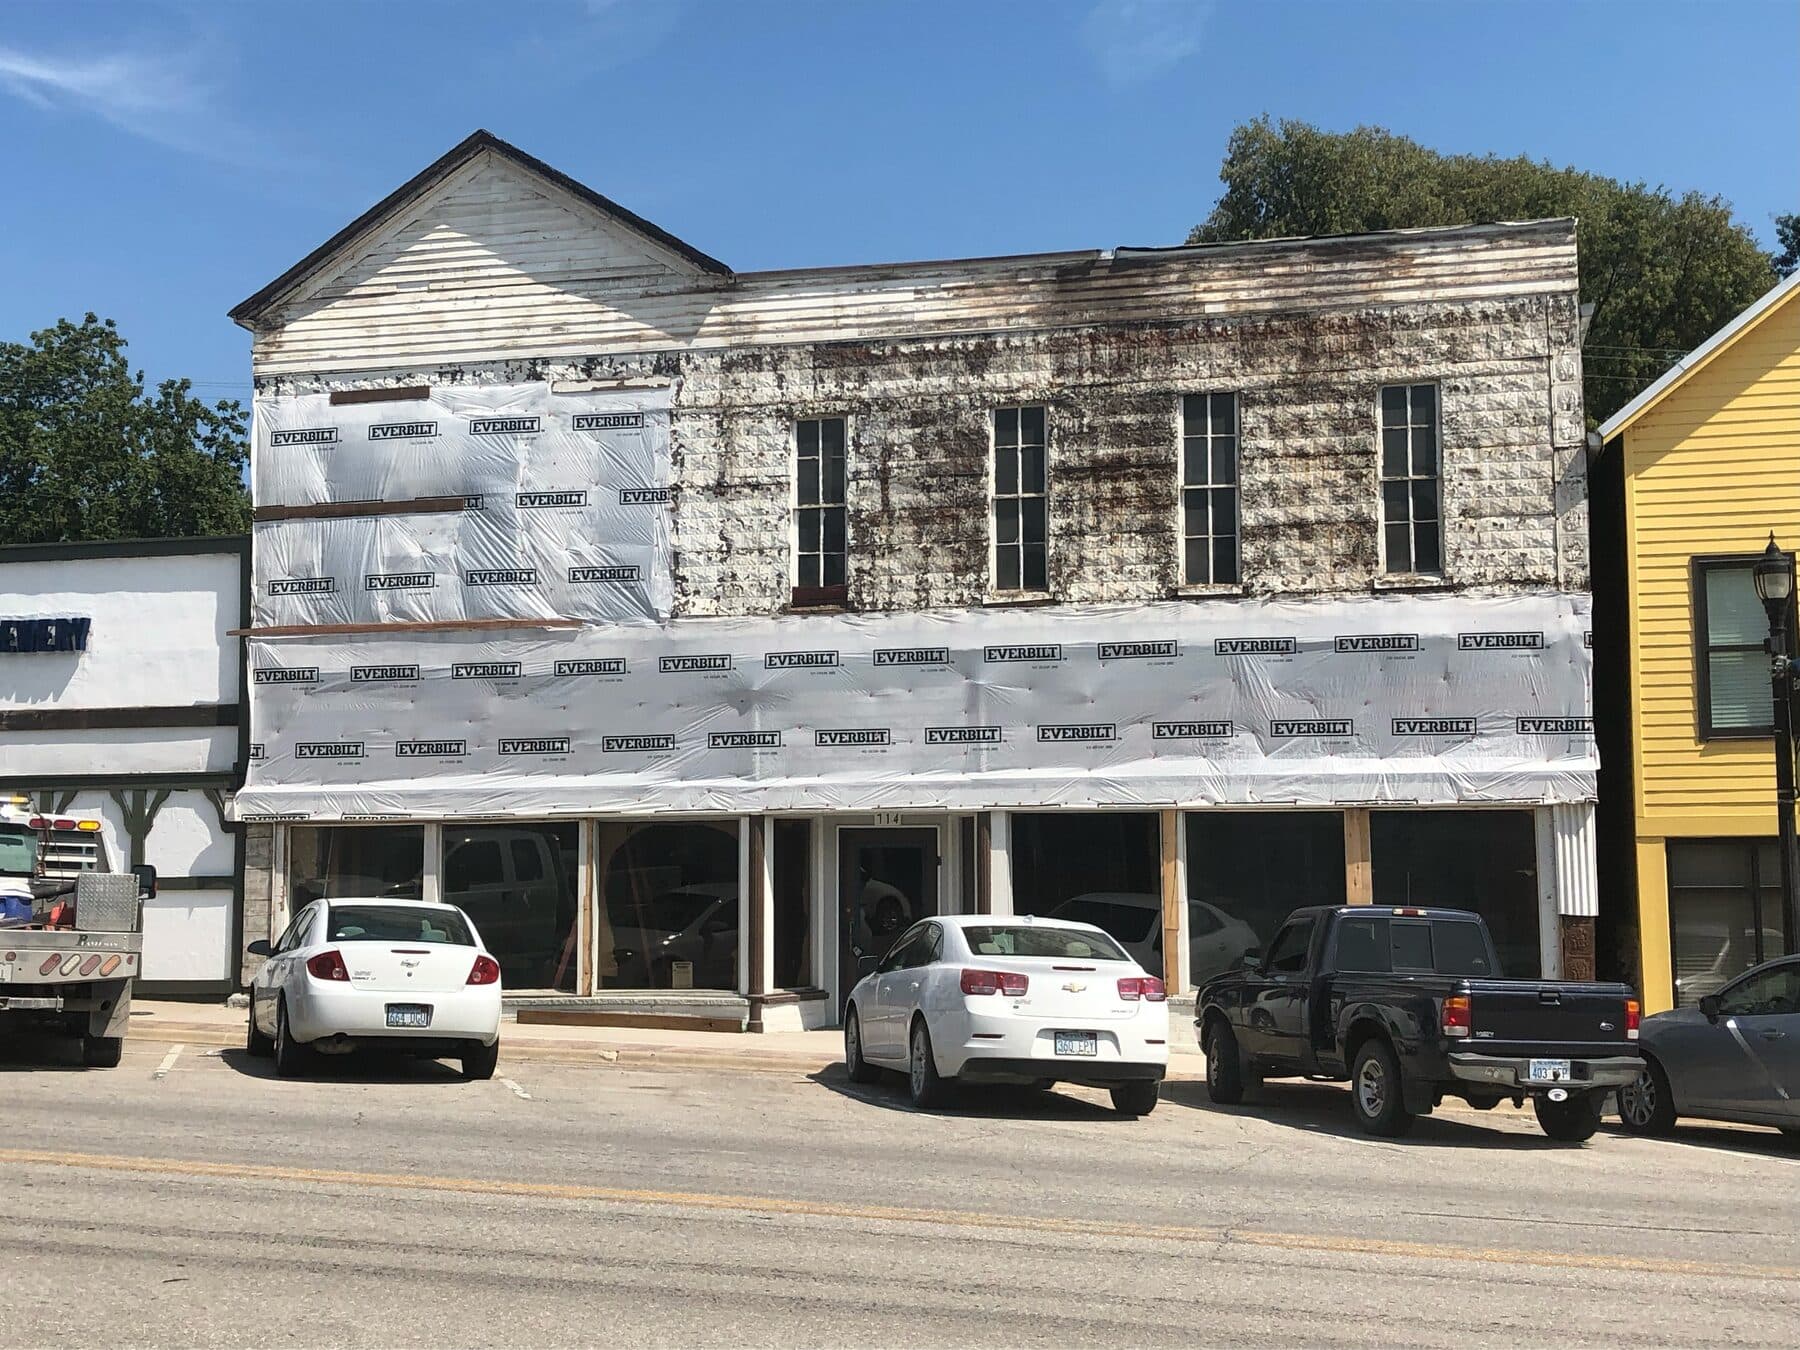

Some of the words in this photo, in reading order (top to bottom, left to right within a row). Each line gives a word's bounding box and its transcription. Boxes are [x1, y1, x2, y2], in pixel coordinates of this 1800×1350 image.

[472, 419, 537, 433] EVERBILT
[575, 414, 642, 429] EVERBILT
[273, 430, 336, 445] EVERBILT
[371, 423, 435, 438] EVERBILT
[518, 493, 584, 507] EVERBILT
[468, 570, 534, 584] EVERBILT
[571, 567, 637, 581] EVERBILT
[270, 578, 332, 594] EVERBILT
[367, 574, 432, 589] EVERBILT
[1218, 639, 1293, 654] EVERBILT
[1338, 636, 1416, 651] EVERBILT
[1461, 634, 1540, 648] EVERBILT
[876, 650, 946, 664] EVERBILT
[986, 646, 1058, 661] EVERBILT
[1100, 642, 1174, 658] EVERBILT
[661, 656, 728, 671] EVERBILT
[767, 652, 836, 667] EVERBILT
[353, 666, 417, 680] EVERBILT
[454, 664, 519, 677] EVERBILT
[556, 660, 623, 675] EVERBILT
[255, 669, 316, 682] EVERBILT
[1040, 726, 1113, 740] EVERBILT
[1155, 723, 1230, 737] EVERBILT
[1273, 721, 1350, 735] EVERBILT
[1394, 720, 1473, 734] EVERBILT
[710, 733, 778, 747] EVERBILT
[818, 731, 888, 744] EVERBILT
[928, 728, 999, 742] EVERBILT
[398, 742, 464, 755] EVERBILT
[500, 739, 568, 753] EVERBILT
[605, 736, 672, 750] EVERBILT
[298, 744, 362, 757] EVERBILT
[1532, 1067, 1548, 1079] 403
